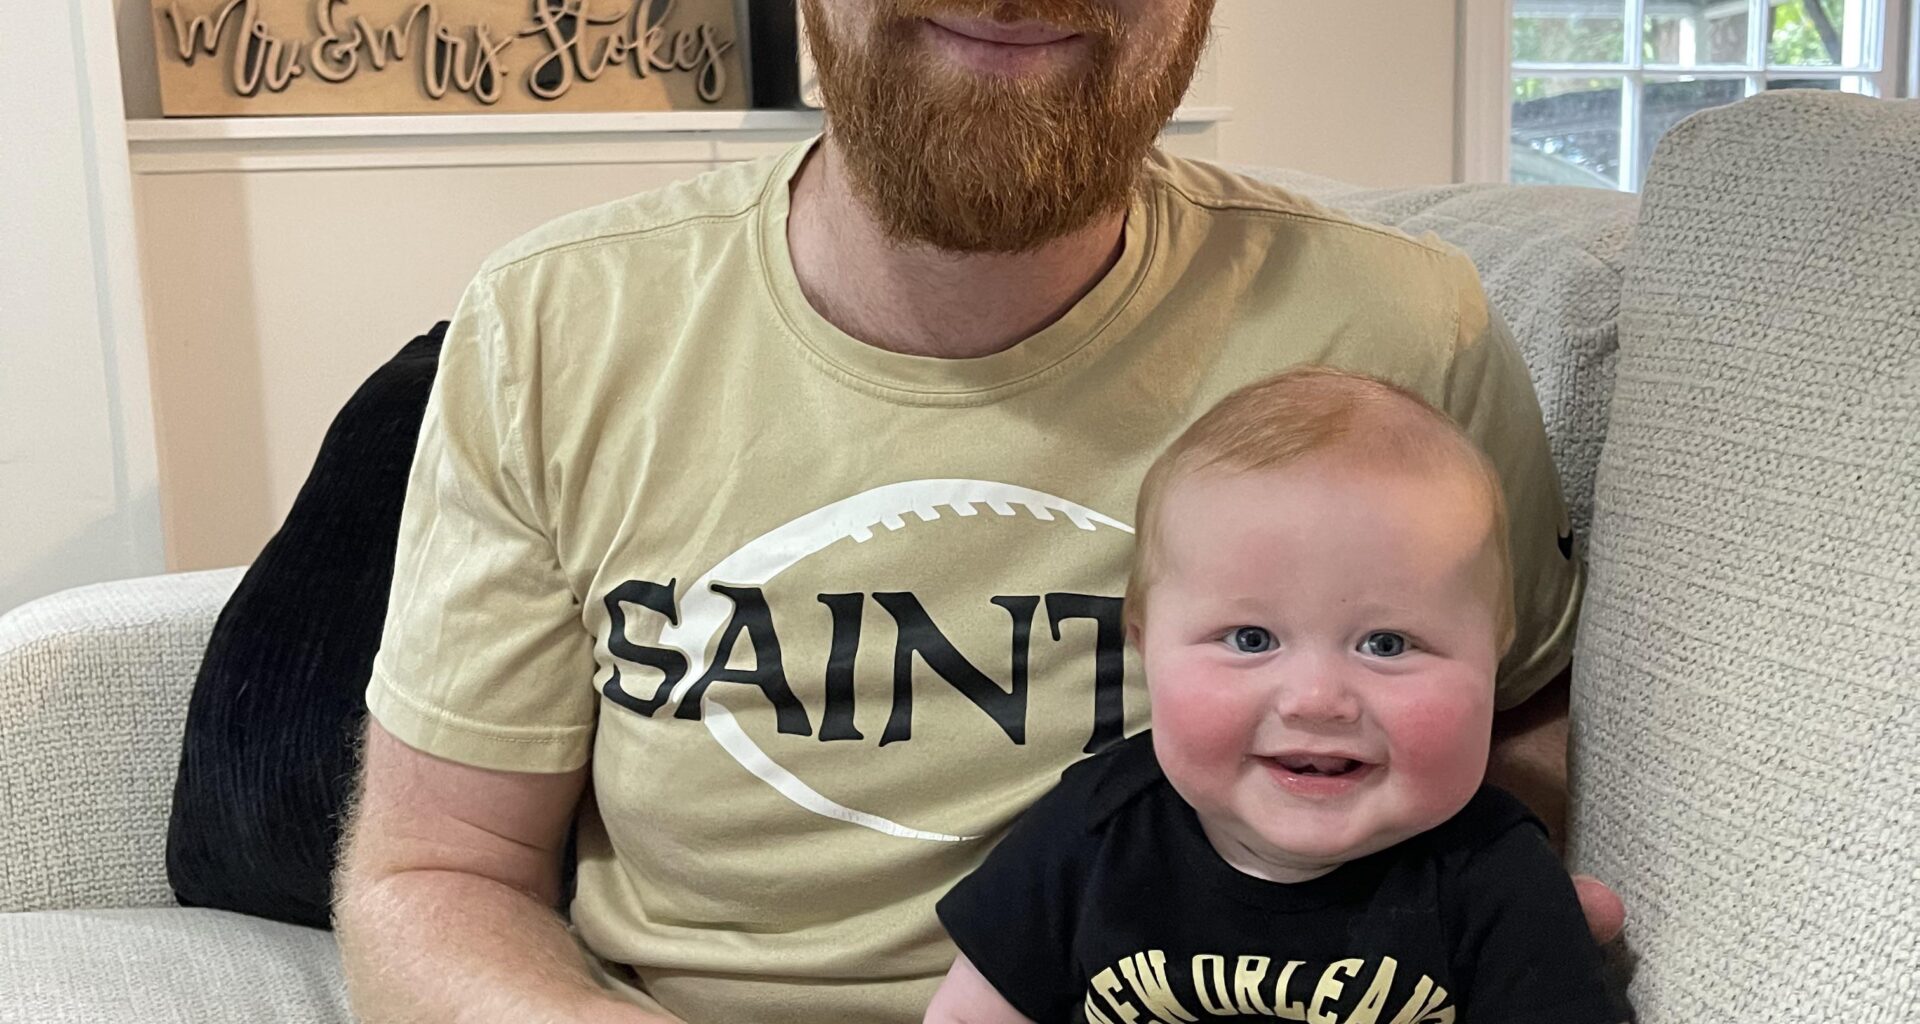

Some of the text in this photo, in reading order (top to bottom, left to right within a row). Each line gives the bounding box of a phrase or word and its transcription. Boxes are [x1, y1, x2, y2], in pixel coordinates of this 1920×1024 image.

[166, 0, 733, 104] Mr. & Mrs. Stokes
